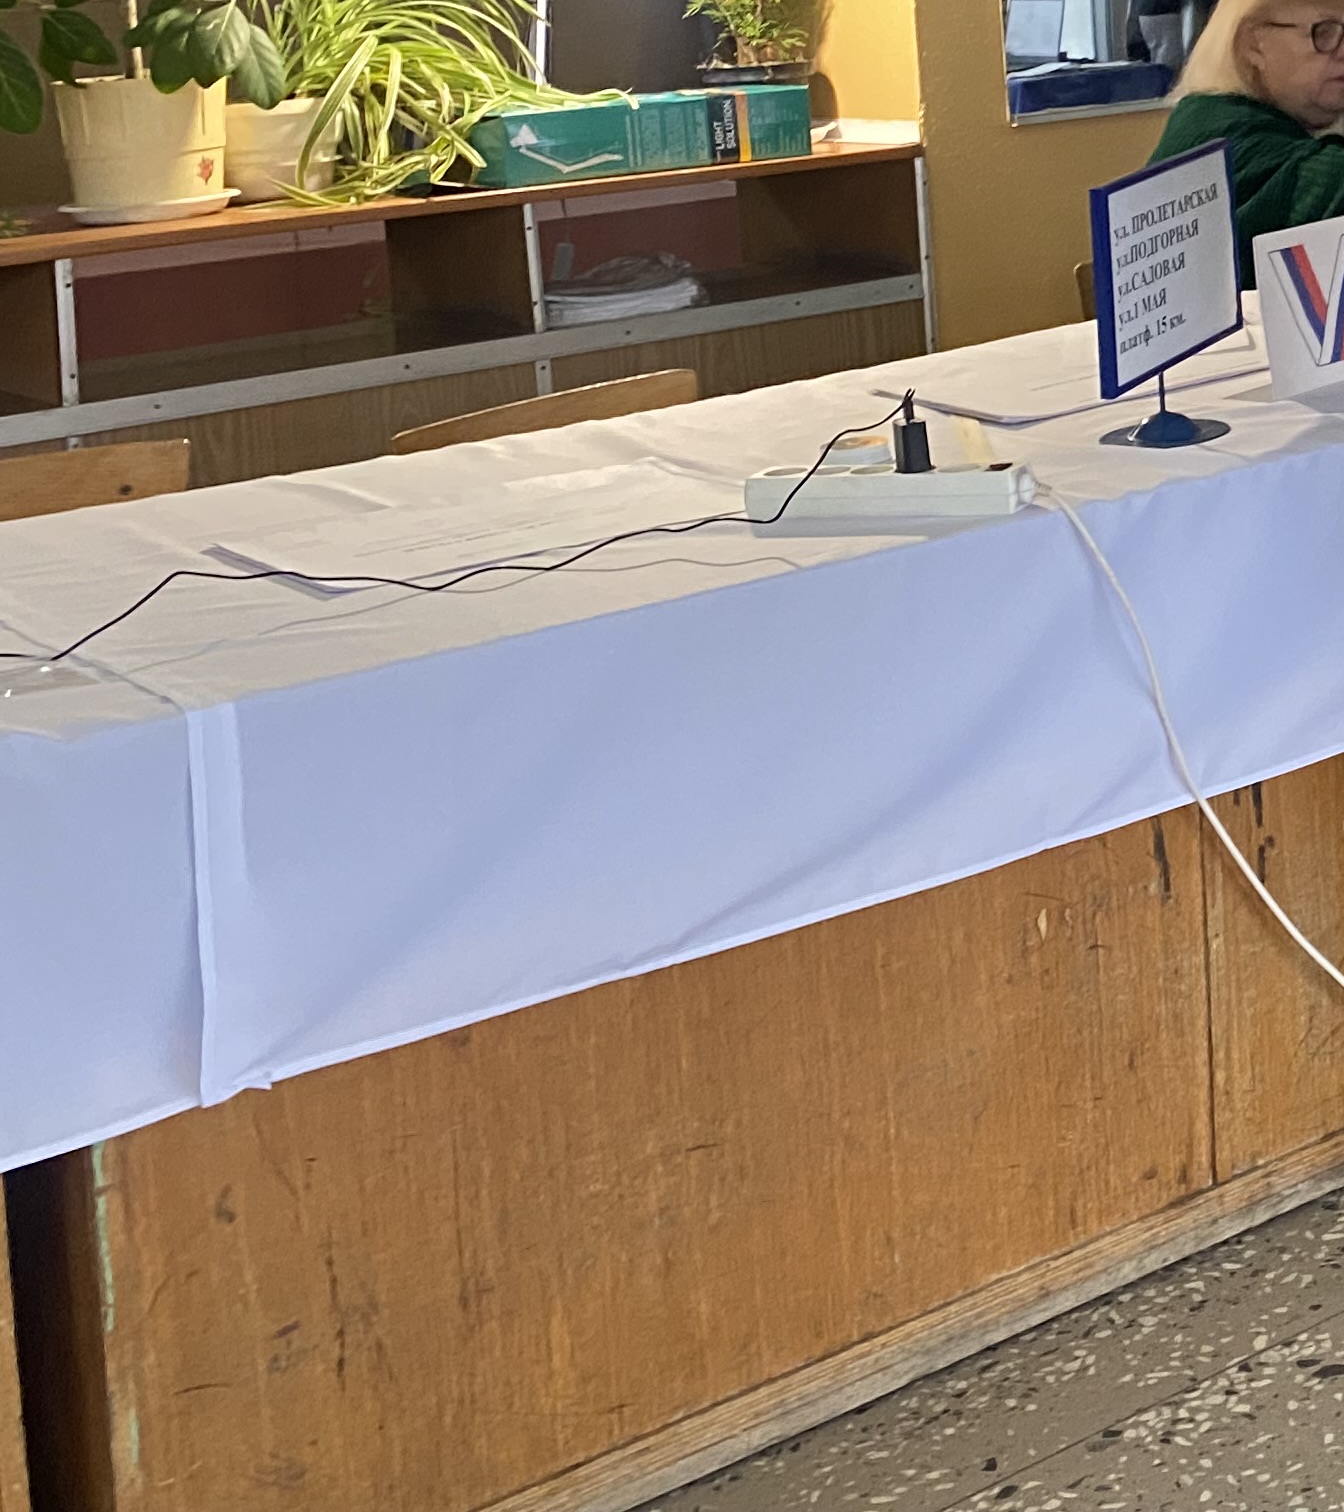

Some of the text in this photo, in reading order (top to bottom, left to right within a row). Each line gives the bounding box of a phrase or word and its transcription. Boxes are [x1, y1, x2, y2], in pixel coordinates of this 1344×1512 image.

[713, 121, 725, 150] LIGHT
[722, 98, 737, 149] SOLUTION
[1131, 183, 1218, 234] ПРОЛЕТАРСКАЯ
[1141, 288, 1167, 317] МАЯ
[1120, 325, 1154, 354] платф.
[1156, 315, 1168, 336] 15
